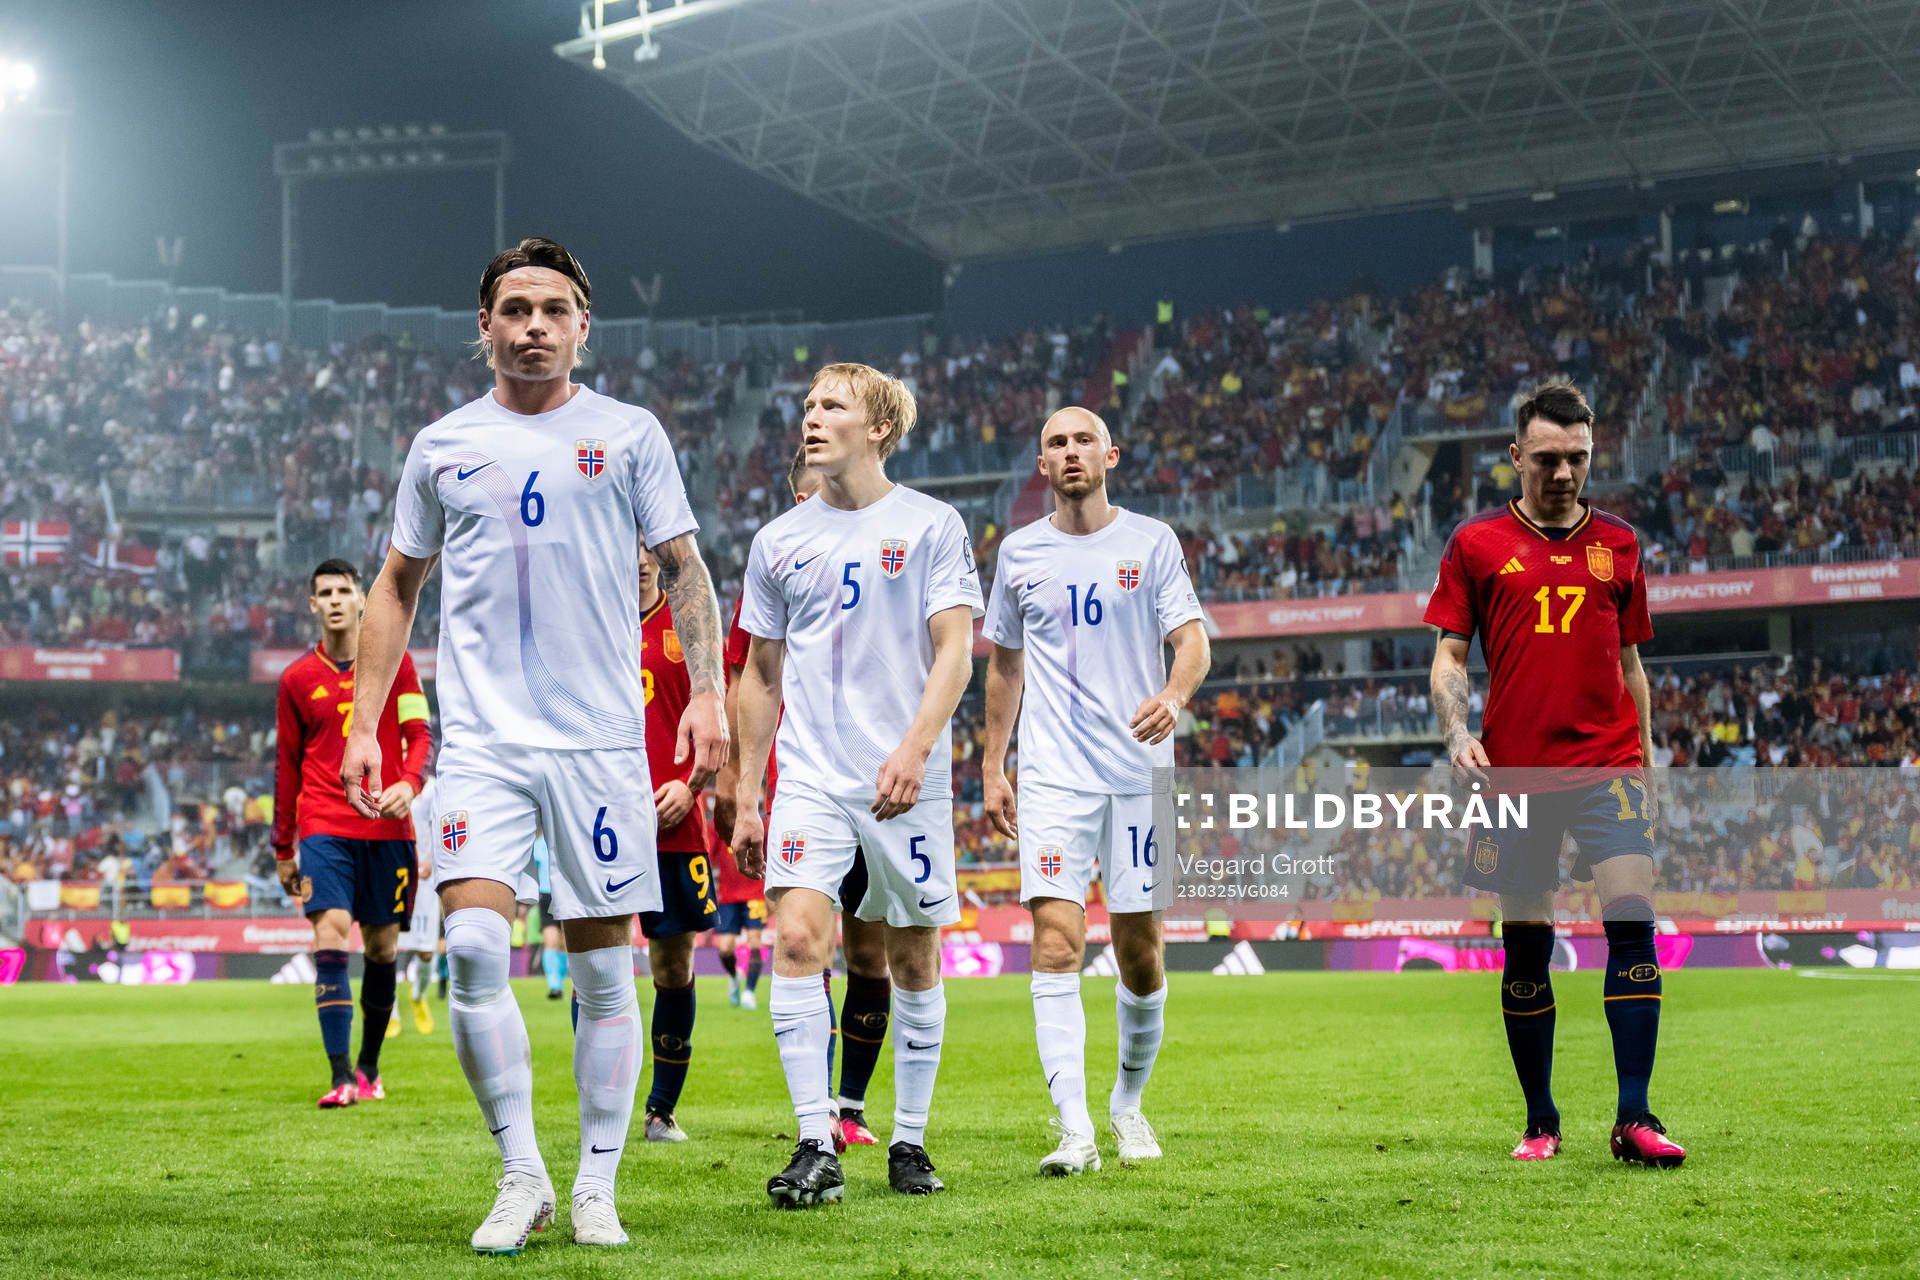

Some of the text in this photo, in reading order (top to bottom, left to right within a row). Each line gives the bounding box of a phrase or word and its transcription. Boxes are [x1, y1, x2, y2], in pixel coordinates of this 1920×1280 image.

[520, 470, 545, 528] 6
[841, 561, 861, 610] 5
[1066, 582, 1103, 627] 16
[1533, 586, 1586, 634] 17
[592, 806, 619, 863] 6
[1127, 825, 1159, 868] 16
[689, 855, 710, 900] 9
[909, 835, 931, 884] 5
